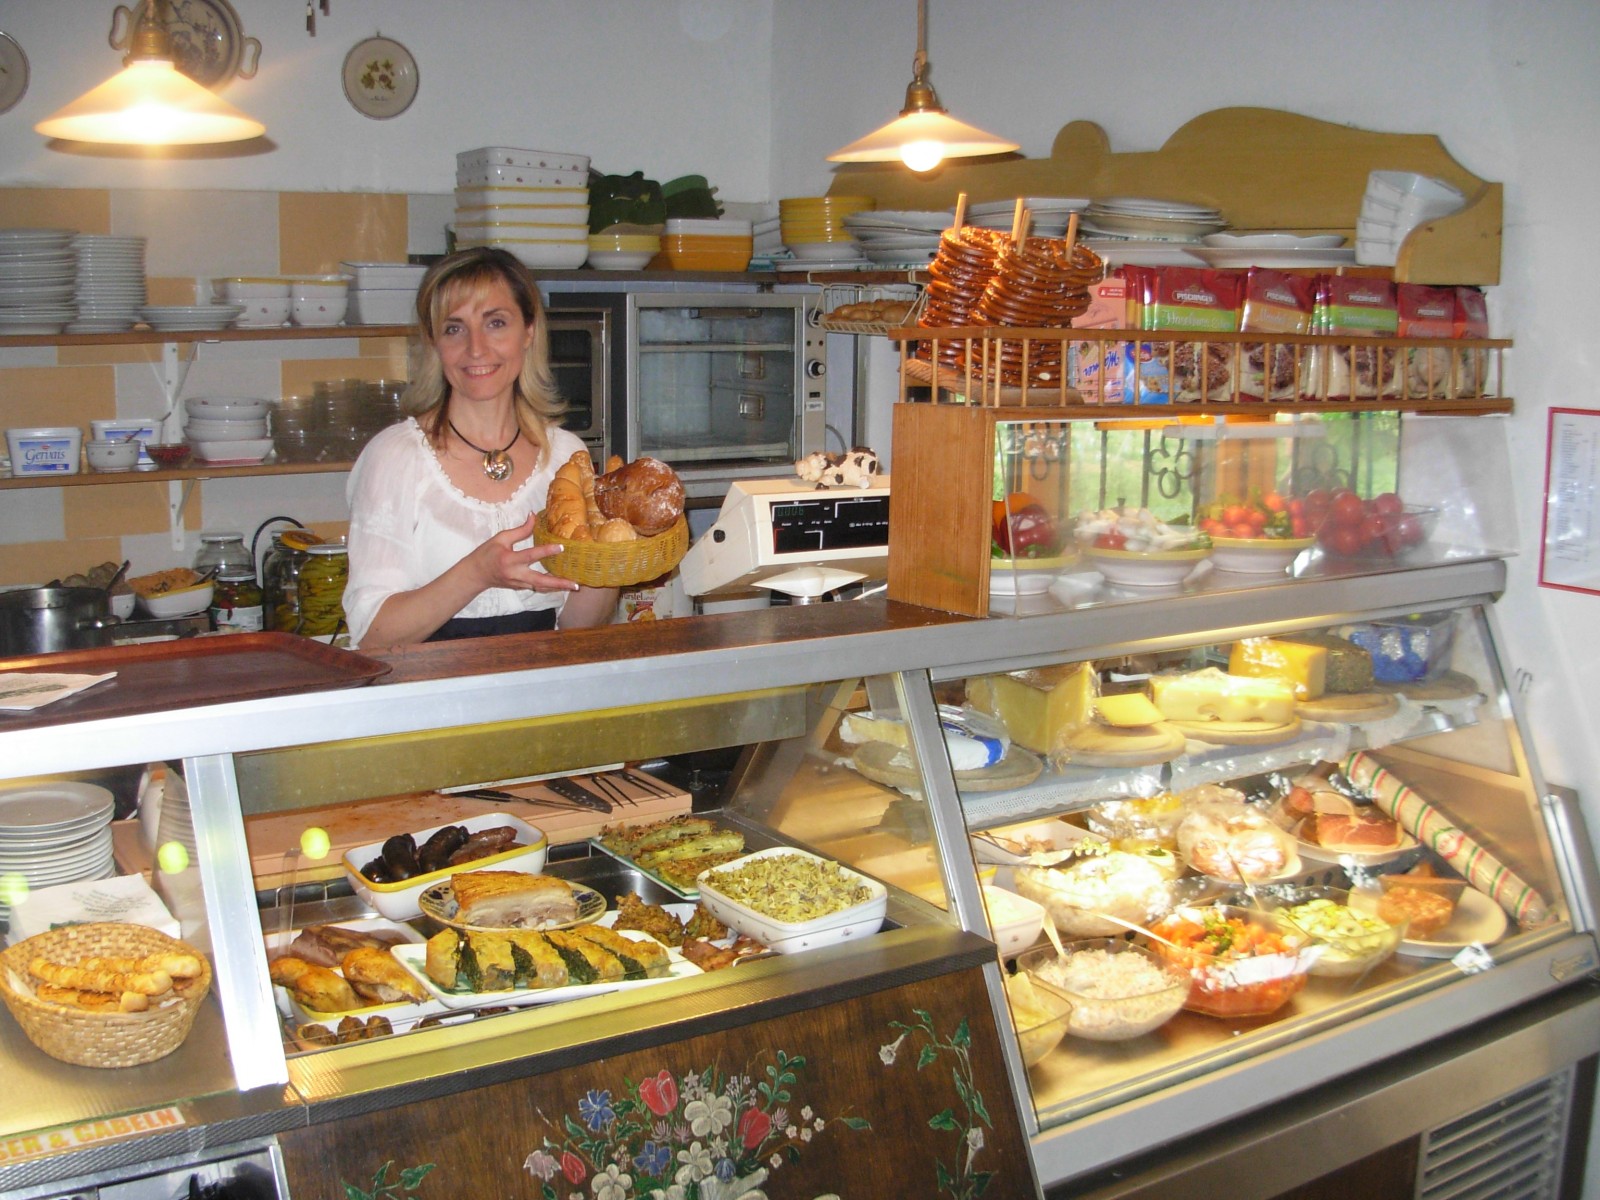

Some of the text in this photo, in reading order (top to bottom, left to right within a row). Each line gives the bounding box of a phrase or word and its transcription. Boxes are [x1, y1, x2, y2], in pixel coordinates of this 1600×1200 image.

[25, 448, 65, 464] Gervais
[48, 1132, 70, 1148] &
[72, 1108, 178, 1143] GABELN
